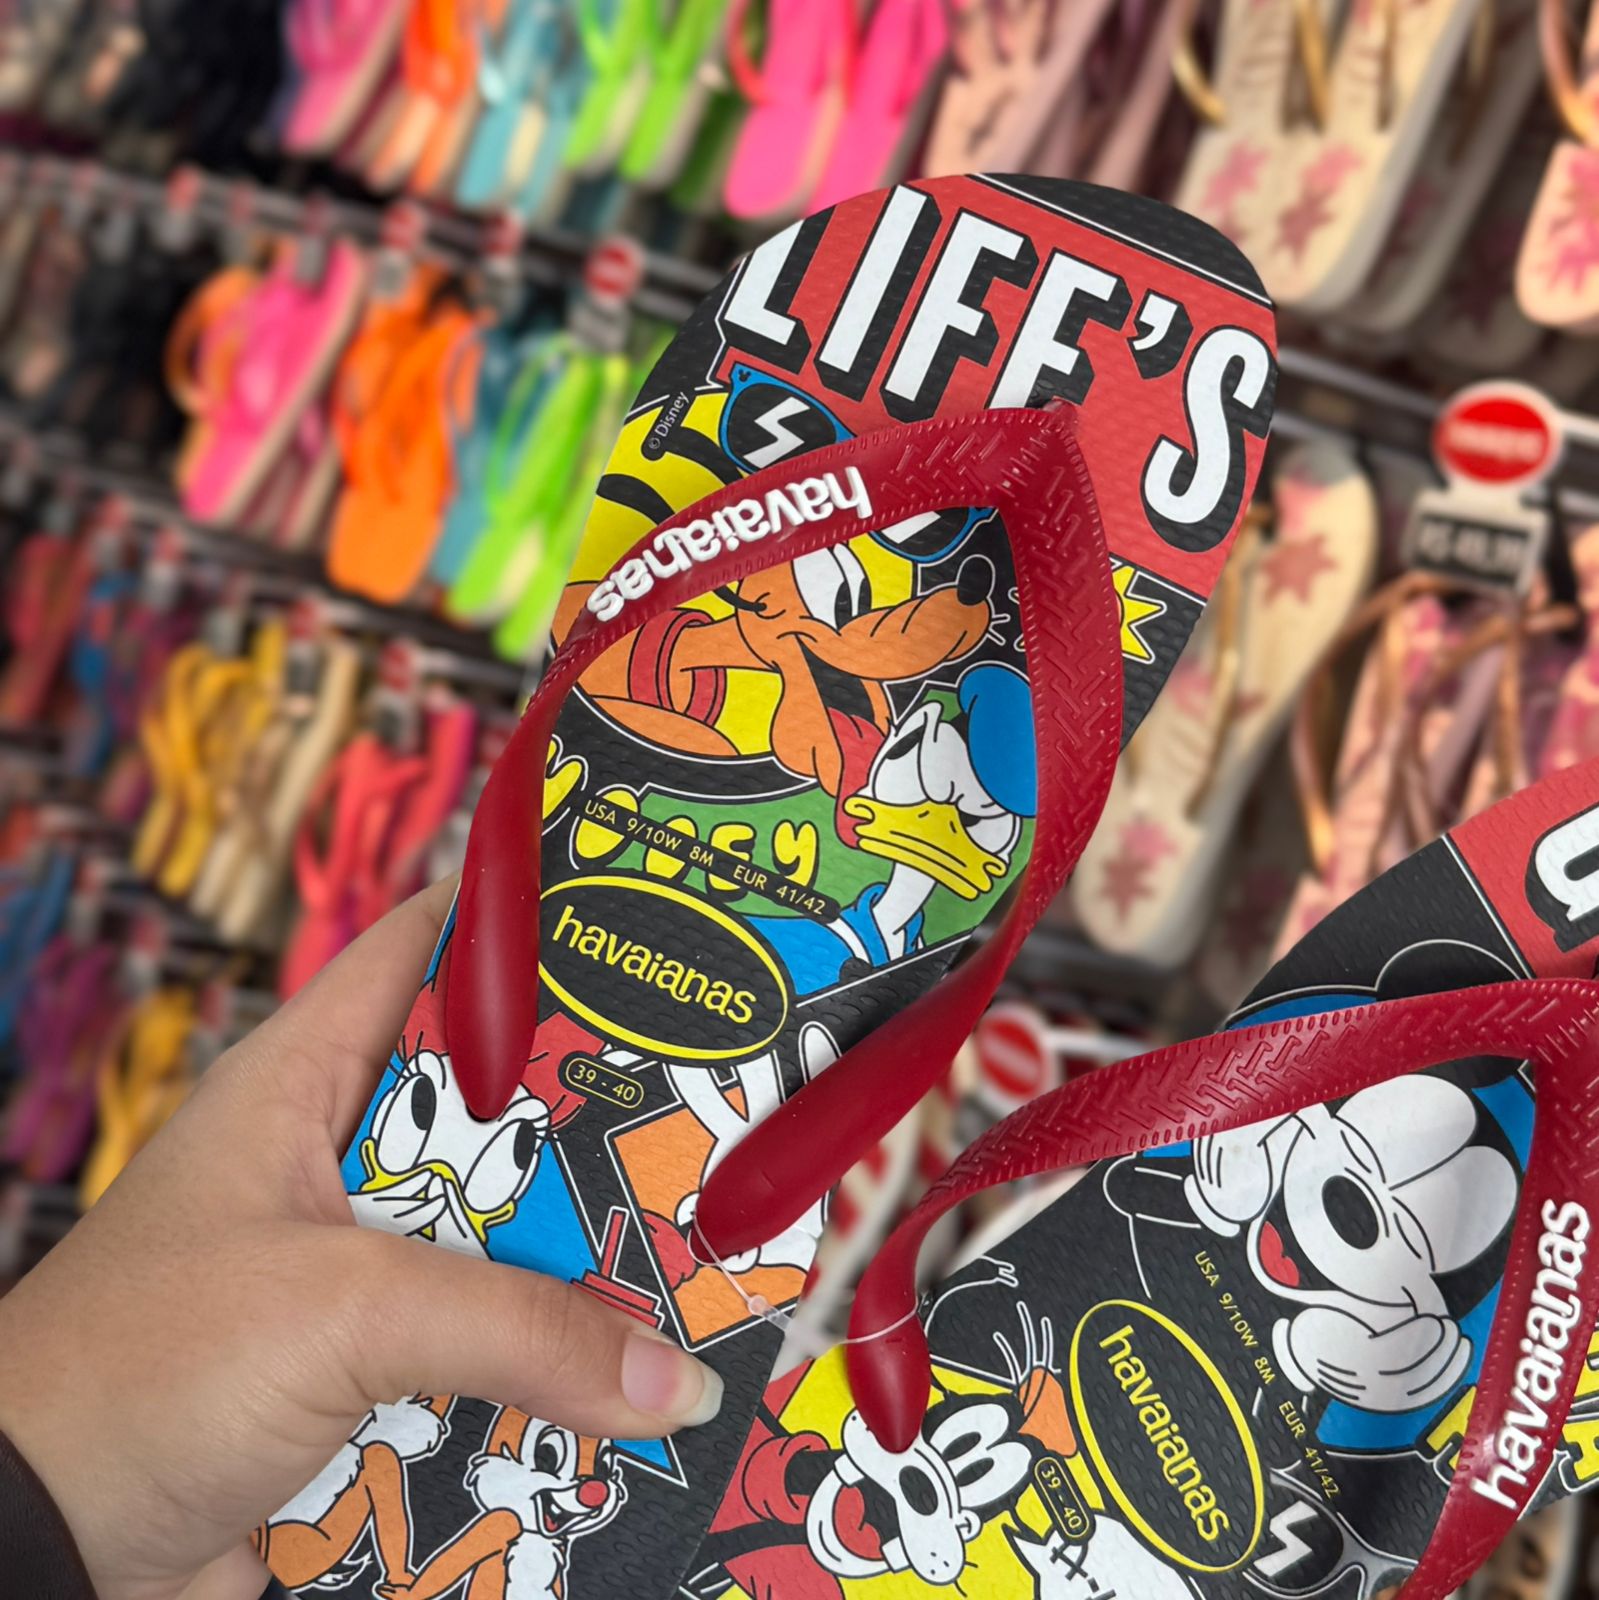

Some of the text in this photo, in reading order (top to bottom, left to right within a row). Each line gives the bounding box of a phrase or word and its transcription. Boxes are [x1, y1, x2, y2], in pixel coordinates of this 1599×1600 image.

[653, 391, 690, 438] Disney
[587, 466, 874, 622] havaianas
[584, 799, 827, 916] USA 9/10W 8M EUR 41/42
[552, 904, 758, 1024] havaianas
[572, 1062, 598, 1084] 39
[611, 1083, 639, 1104] 40
[1194, 1249, 1340, 1499] USA 9/10W 8M EUR 41/42
[1471, 1199, 1591, 1510] havaianas
[1098, 1324, 1231, 1544] havaianas
[1041, 1465, 1062, 1489] 39
[1062, 1506, 1083, 1529] 40
